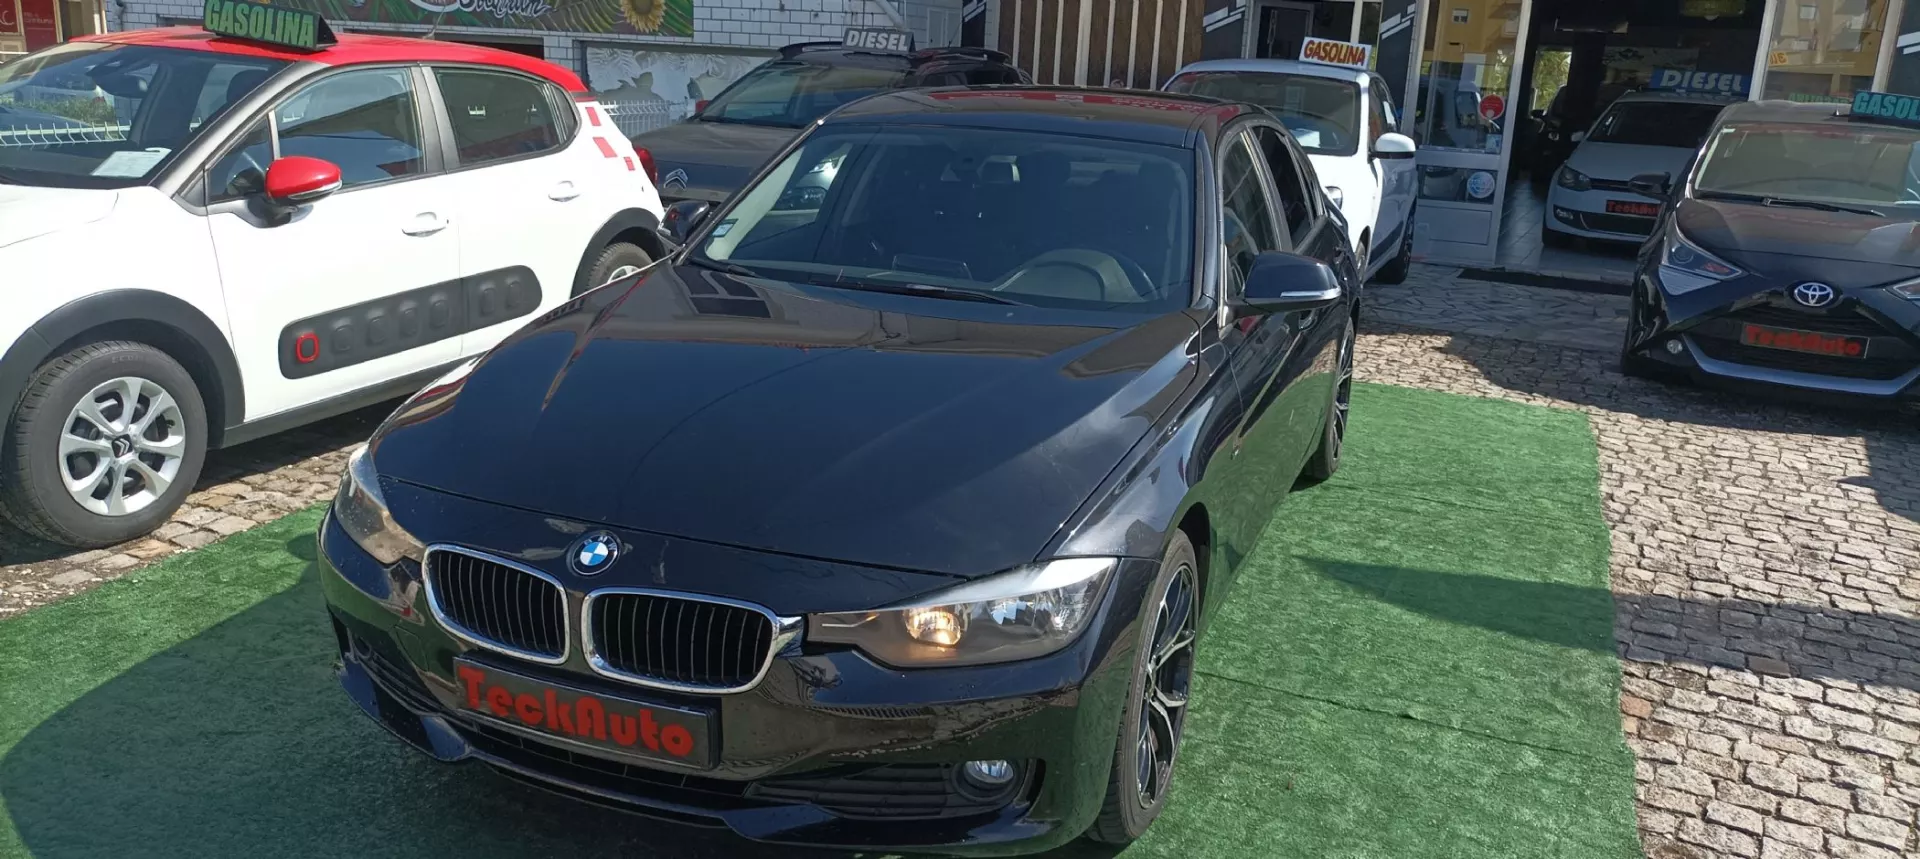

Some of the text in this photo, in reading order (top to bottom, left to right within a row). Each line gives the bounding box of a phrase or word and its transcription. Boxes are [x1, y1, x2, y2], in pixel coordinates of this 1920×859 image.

[204, 0, 315, 48] GASOLINA
[846, 30, 909, 52] DIESEL
[1304, 39, 1366, 66] GASOLINA
[1660, 69, 1743, 92] DIESEL
[1853, 92, 1920, 121] GASOL
[1607, 200, 1660, 216] TeckAu
[1745, 324, 1862, 356] TeckAuto
[458, 664, 694, 757] TeckAuto
